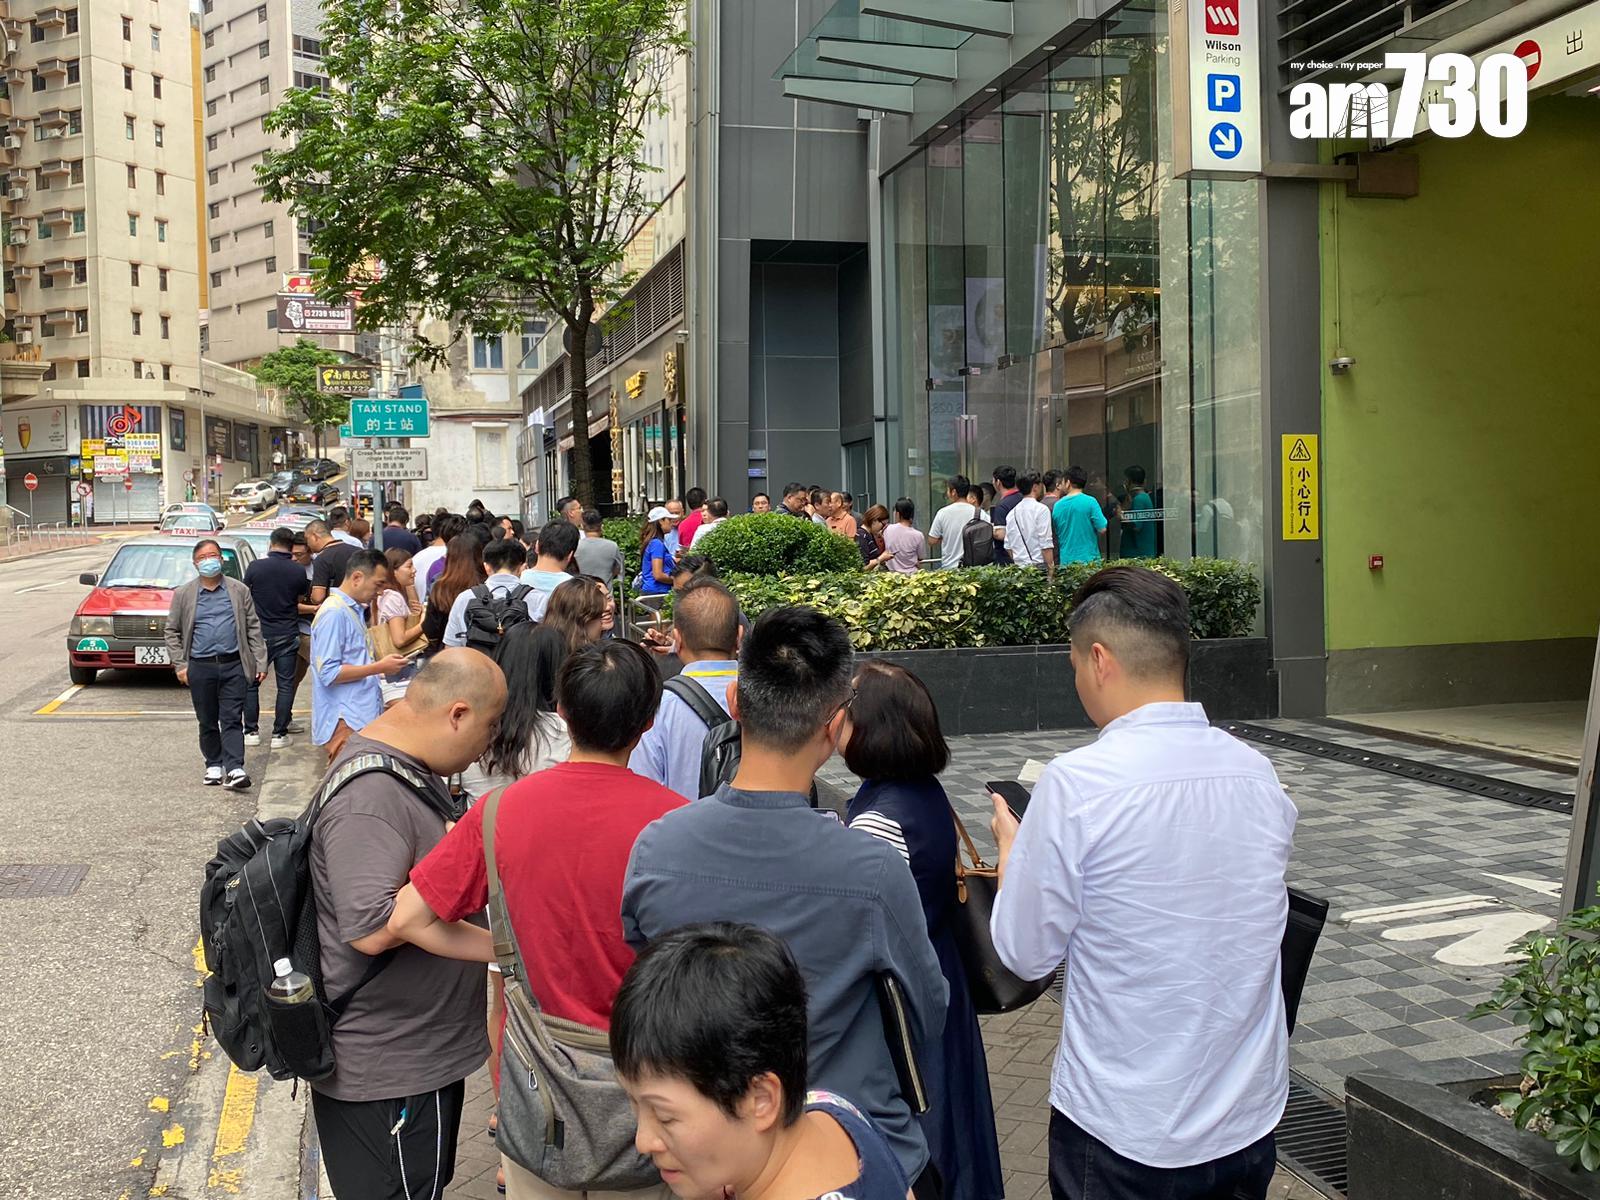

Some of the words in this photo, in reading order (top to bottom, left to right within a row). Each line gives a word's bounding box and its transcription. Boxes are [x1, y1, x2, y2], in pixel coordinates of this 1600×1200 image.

[1205, 40, 1241, 51] Wilson
[1566, 29, 1583, 55] 出
[1206, 53, 1240, 67] Parking
[1215, 80, 1235, 106] P
[357, 404, 381, 413] TAXI
[385, 404, 422, 413] STAND
[366, 417, 414, 431] 的士站
[1298, 467, 1311, 533] 小心行人
[174, 527, 195, 535] TAXI
[145, 647, 160, 655] XR
[141, 656, 164, 664] 623
